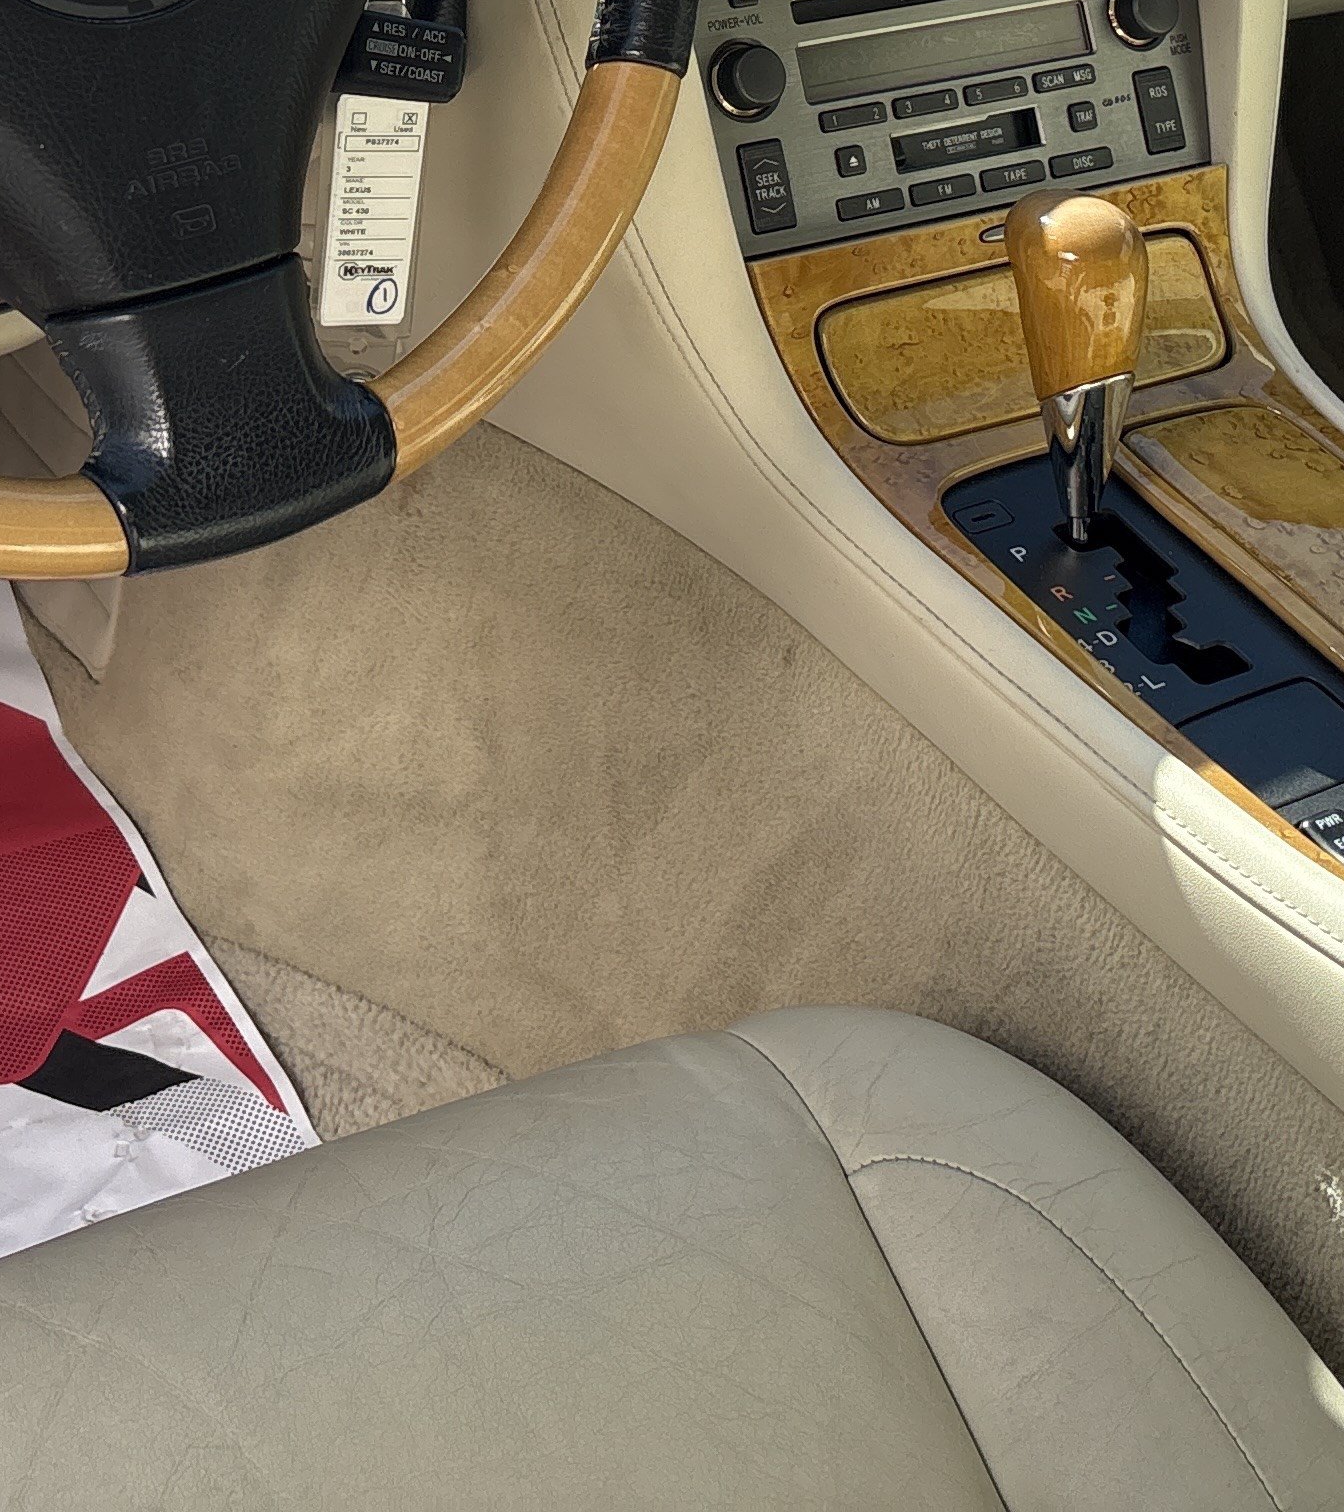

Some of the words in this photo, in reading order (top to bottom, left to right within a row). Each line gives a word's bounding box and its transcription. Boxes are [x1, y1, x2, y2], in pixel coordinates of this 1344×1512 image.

[707, 13, 764, 32] POWER-VOL
[383, 21, 406, 37] RES
[422, 29, 446, 44] ACC
[379, 61, 445, 84] SET/COAST
[1041, 74, 1065, 88] SCAN
[1073, 68, 1092, 82] MSG
[975, 89, 983, 100] 5
[1013, 82, 1021, 94] 6
[905, 101, 913, 113] 3
[944, 93, 951, 105] 4
[832, 114, 838, 126] 1
[872, 108, 881, 120] 2
[1155, 119, 1178, 133] TYPE
[1072, 155, 1095, 170] DISC
[756, 172, 781, 186] SEEK
[1004, 168, 1027, 182] TAPE
[755, 186, 787, 201] TRACK
[937, 184, 952, 196] FM
[865, 198, 880, 210] AM
[1009, 546, 1027, 563] P
[1050, 585, 1074, 603] R
[1073, 607, 1098, 625] N
[1315, 813, 1344, 830] PWR
